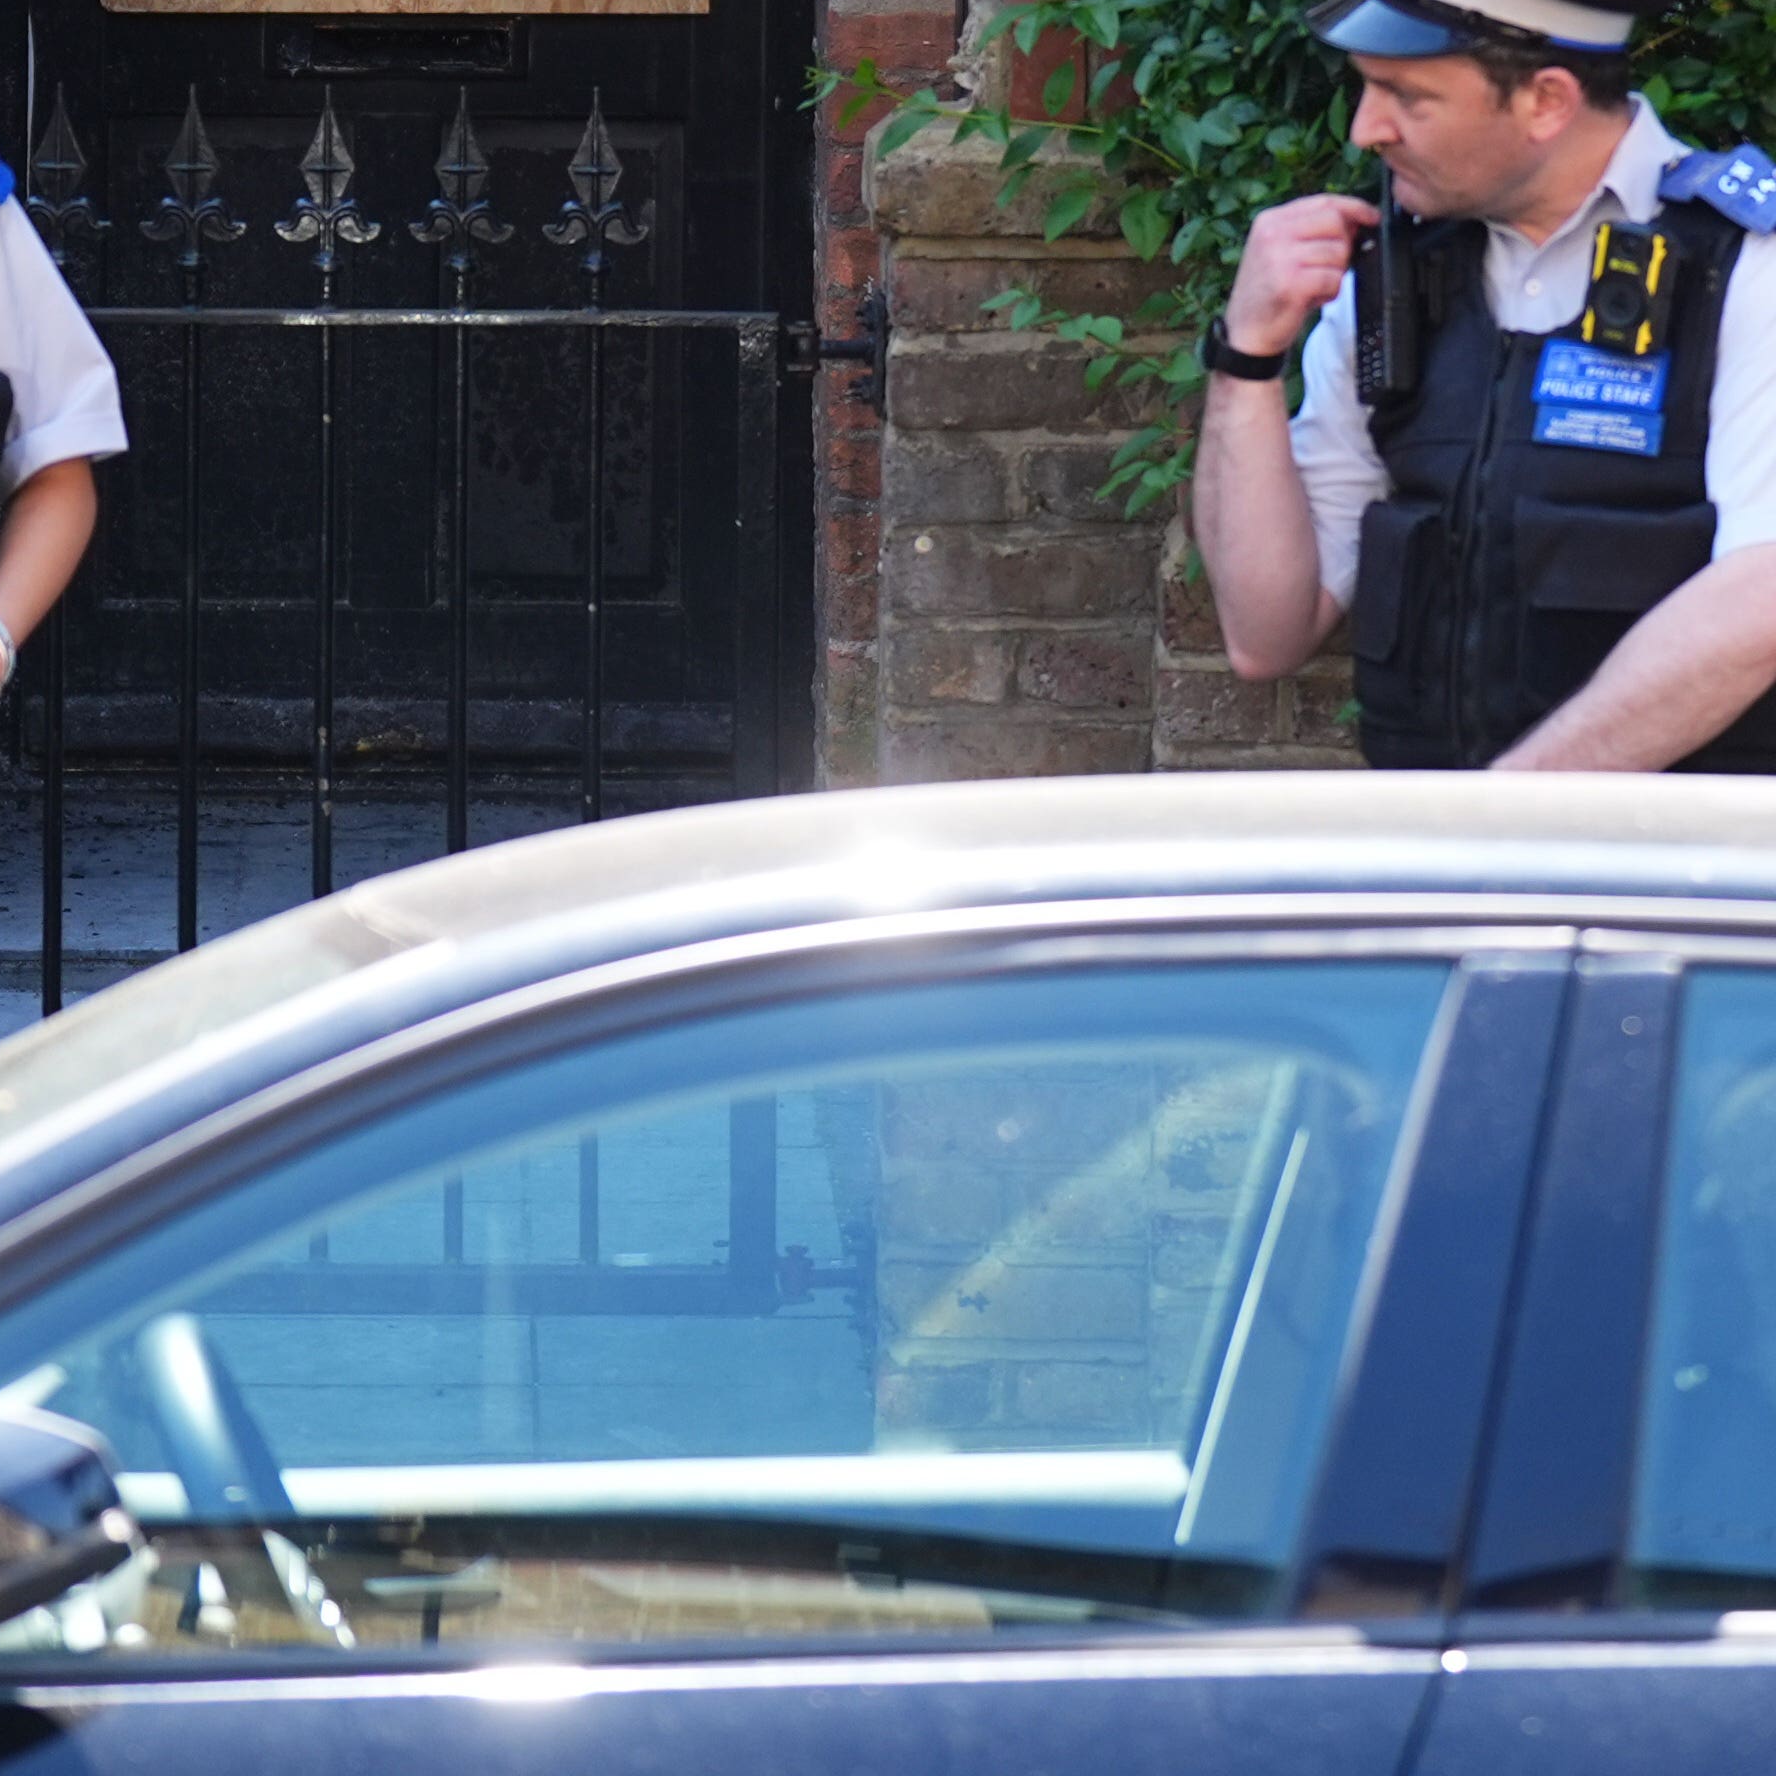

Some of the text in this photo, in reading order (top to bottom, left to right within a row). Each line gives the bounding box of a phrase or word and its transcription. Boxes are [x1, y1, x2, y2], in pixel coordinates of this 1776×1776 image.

[1585, 366, 1642, 383] POLICE
[1539, 378, 1653, 406] POLICE STAFF
